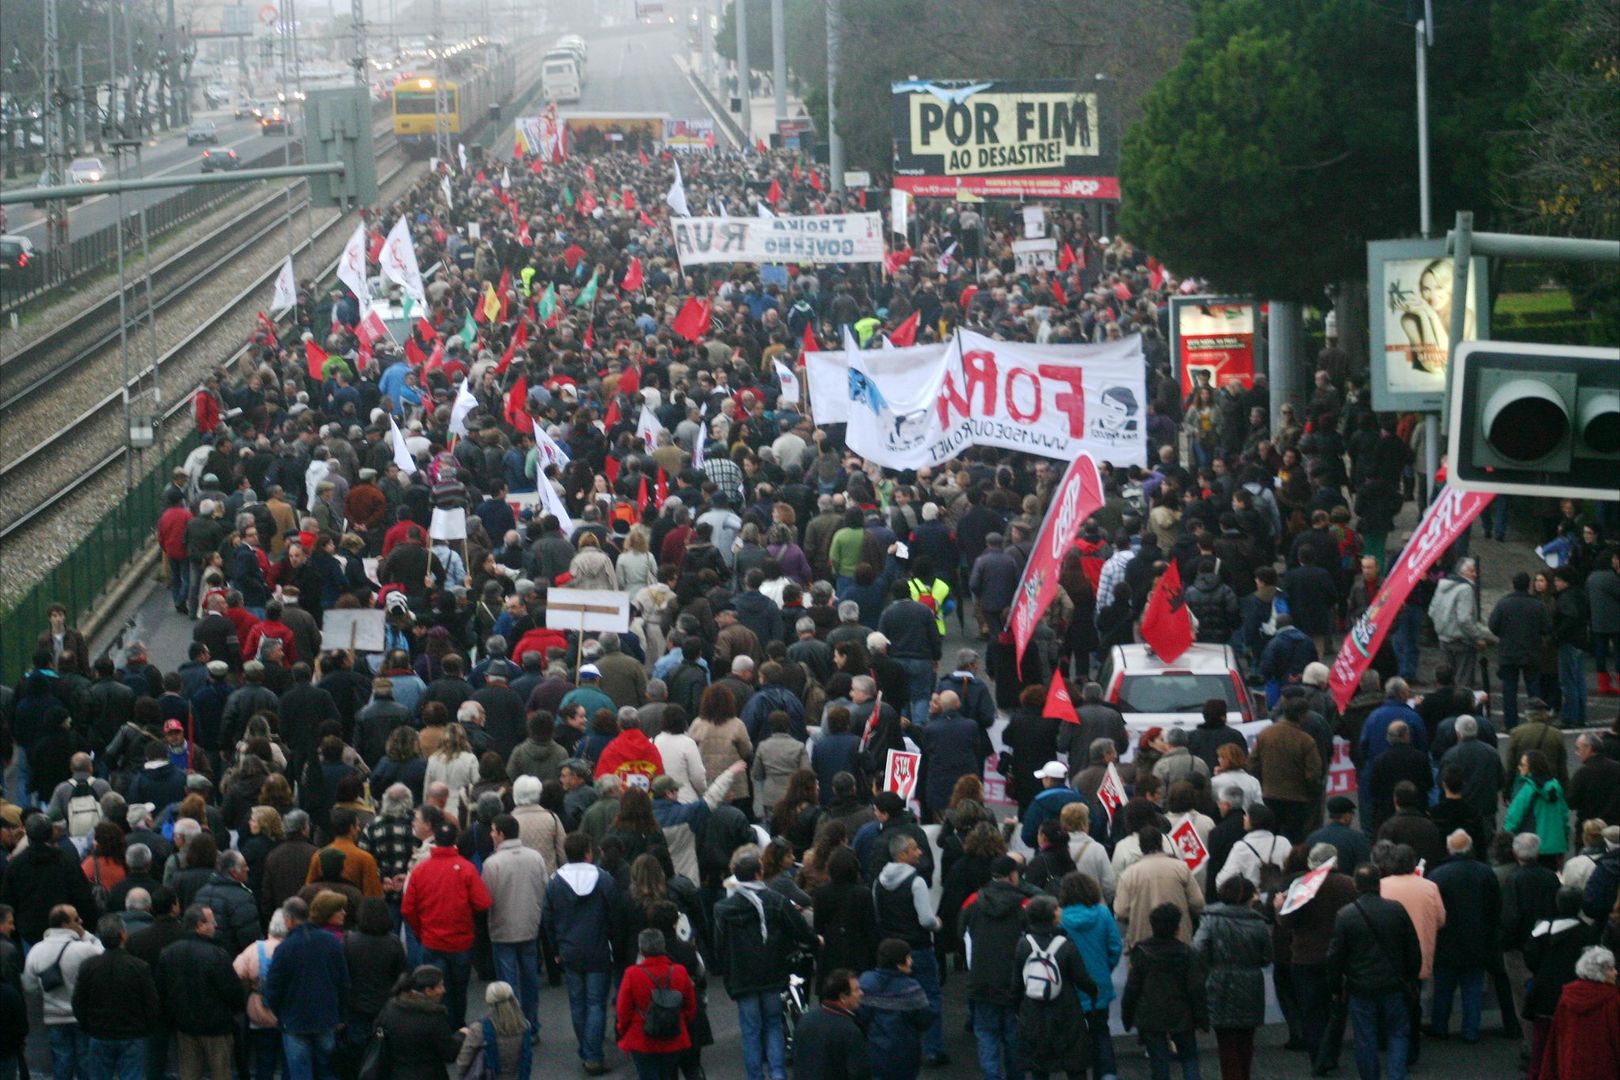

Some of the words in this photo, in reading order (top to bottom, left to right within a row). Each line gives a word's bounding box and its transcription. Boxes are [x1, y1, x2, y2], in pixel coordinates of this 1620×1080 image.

[920, 102, 1000, 147] POR
[1016, 101, 1091, 147] FIM
[950, 150, 971, 170] AO
[978, 140, 1061, 168] DESASTRE!
[1071, 179, 1099, 196] PCP
